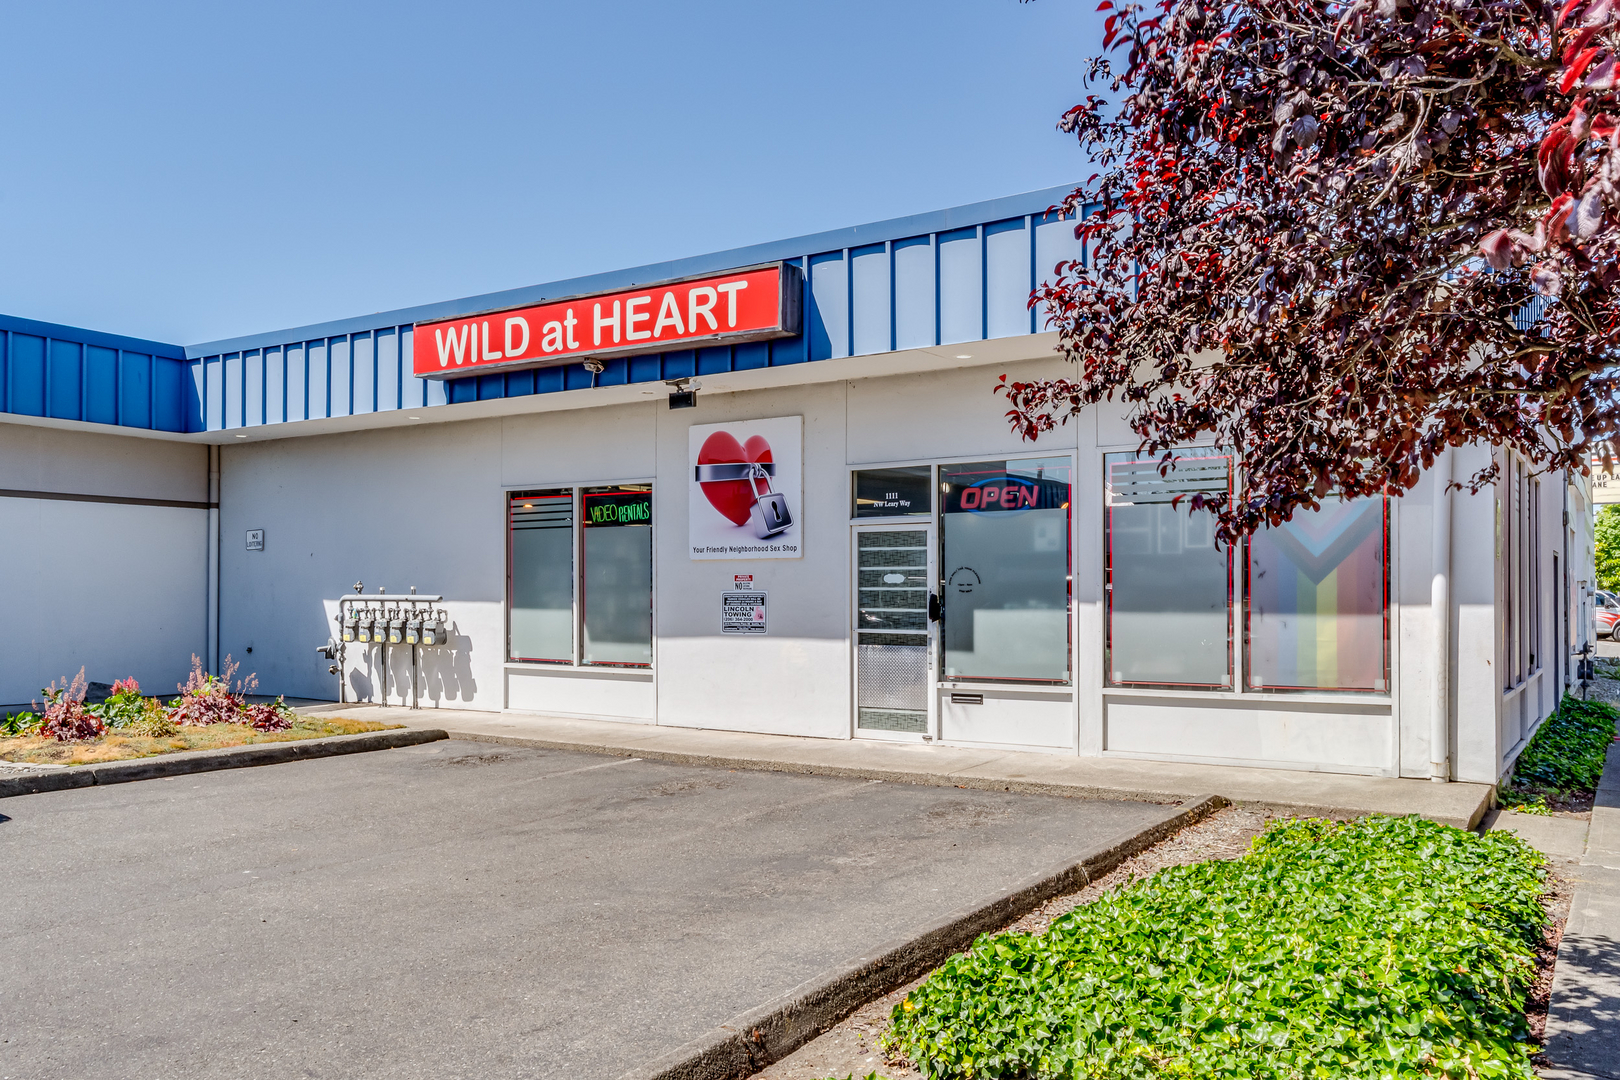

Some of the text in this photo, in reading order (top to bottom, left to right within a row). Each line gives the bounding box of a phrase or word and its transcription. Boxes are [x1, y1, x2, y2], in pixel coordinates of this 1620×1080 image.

[435, 280, 748, 367] WILD at HEART
[885, 492, 898, 500] 1111
[960, 485, 1039, 509] OPEN
[590, 501, 650, 523] VIDEO RENTALS
[252, 532, 259, 540] NO
[692, 544, 798, 554] Your Friendly Neighborhood Sex Shop
[734, 581, 743, 591] NO
